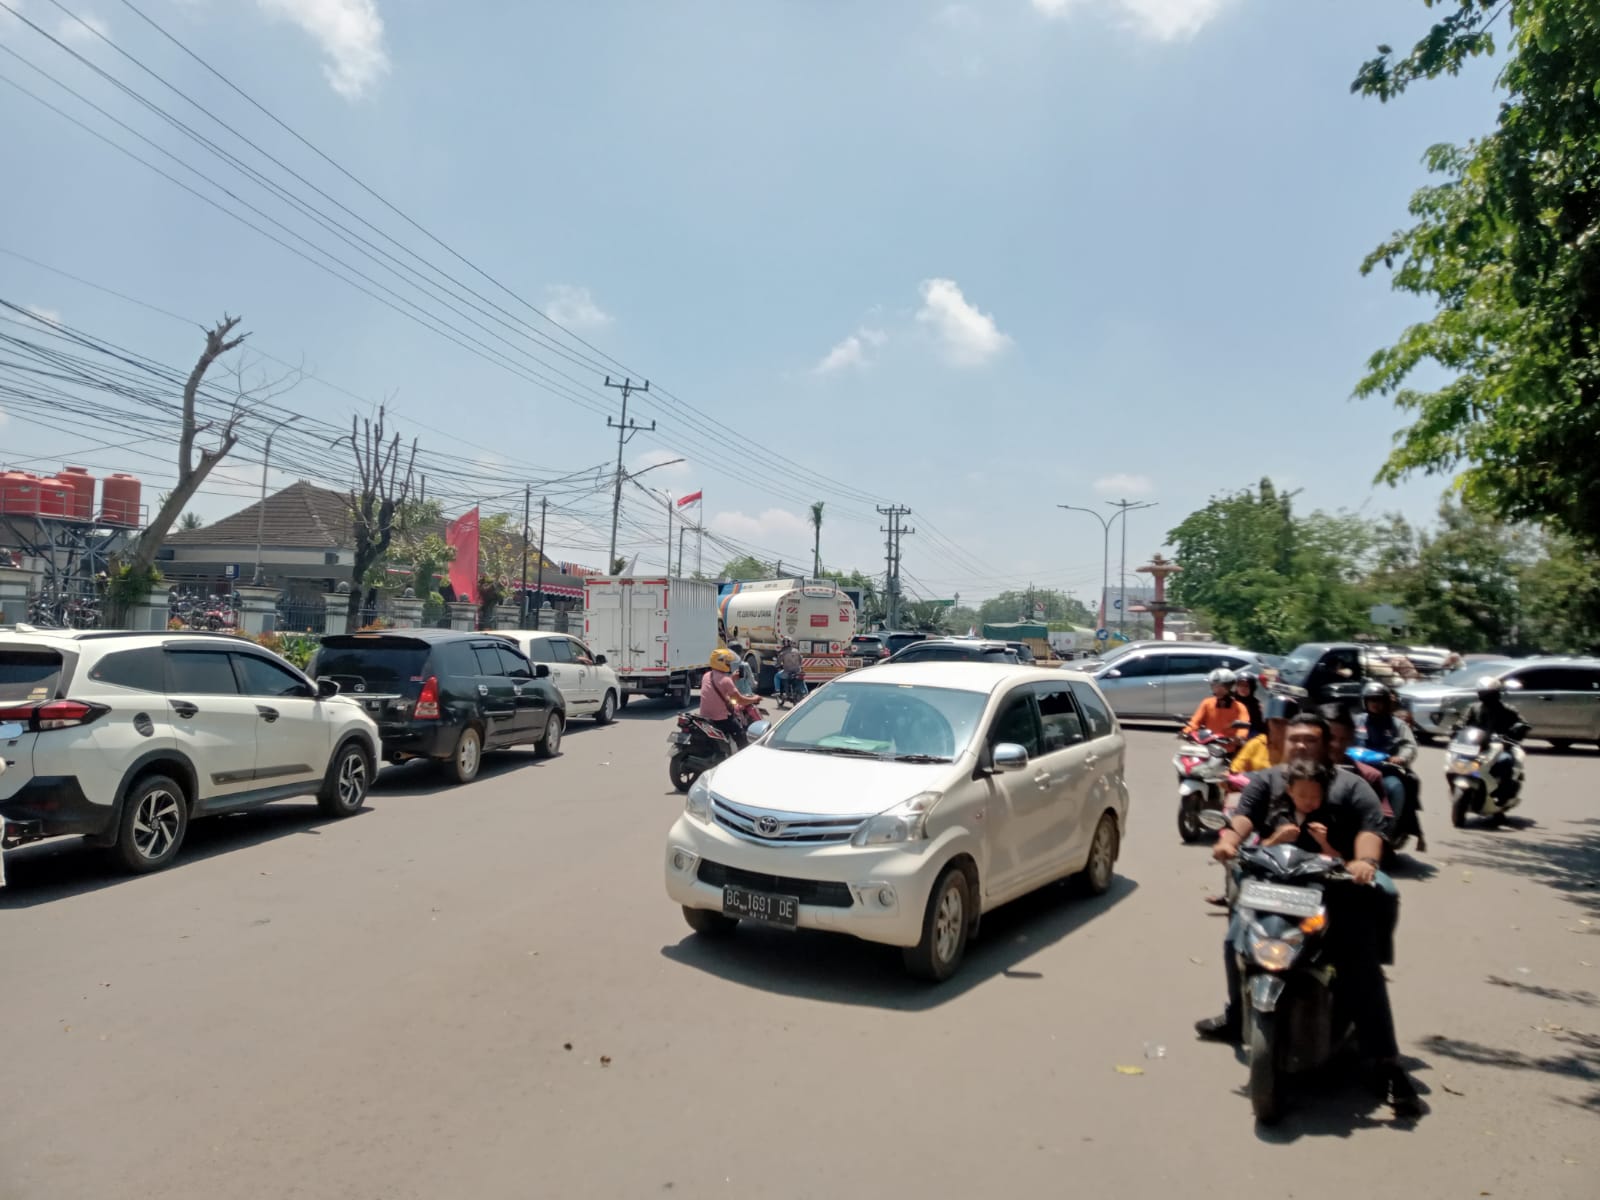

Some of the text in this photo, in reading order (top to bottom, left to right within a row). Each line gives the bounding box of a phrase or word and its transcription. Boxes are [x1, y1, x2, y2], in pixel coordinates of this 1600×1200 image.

[726, 889, 740, 905] BG
[748, 894, 771, 914] 1691
[779, 900, 792, 918] DE
